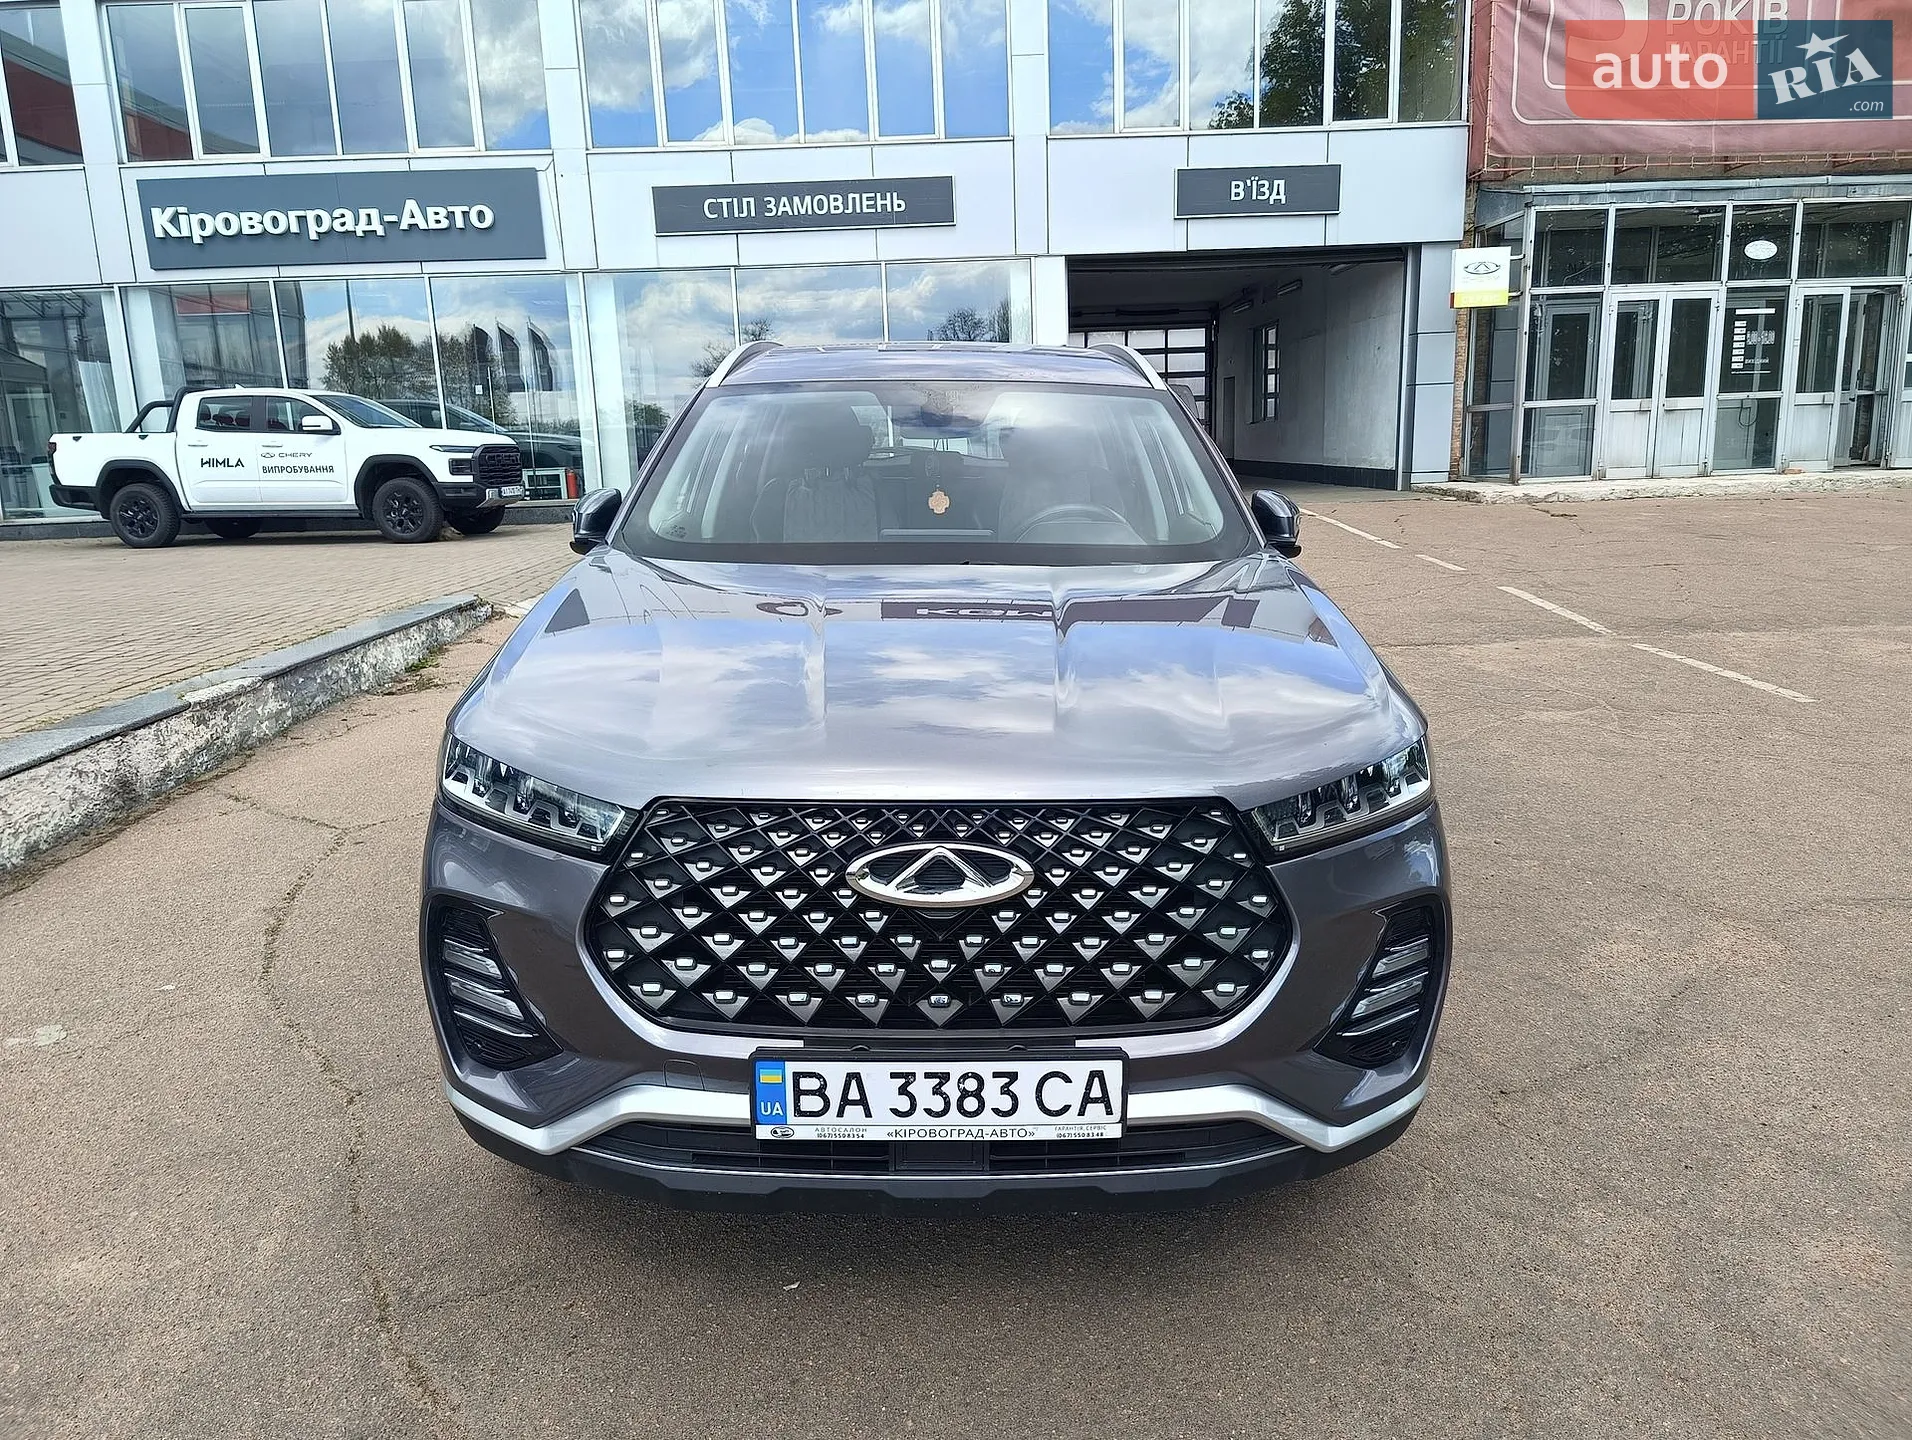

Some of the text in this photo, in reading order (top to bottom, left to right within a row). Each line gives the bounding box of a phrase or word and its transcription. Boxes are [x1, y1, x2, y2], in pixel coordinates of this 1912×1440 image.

[1666, 0, 1789, 35] РОКІВ
[703, 191, 907, 219] СТІЛ ЗАМОВЛЕНЬ
[150, 199, 496, 244] Кіровоград-Авто
[200, 457, 245, 468] HIMLA
[262, 465, 335, 474] ВИПРОБУВАННЯ
[791, 1069, 1114, 1119] BA 3383 CA
[760, 1101, 784, 1116] UA
[886, 1127, 1036, 1140] «КІРОВОГРАД-АВТО»
